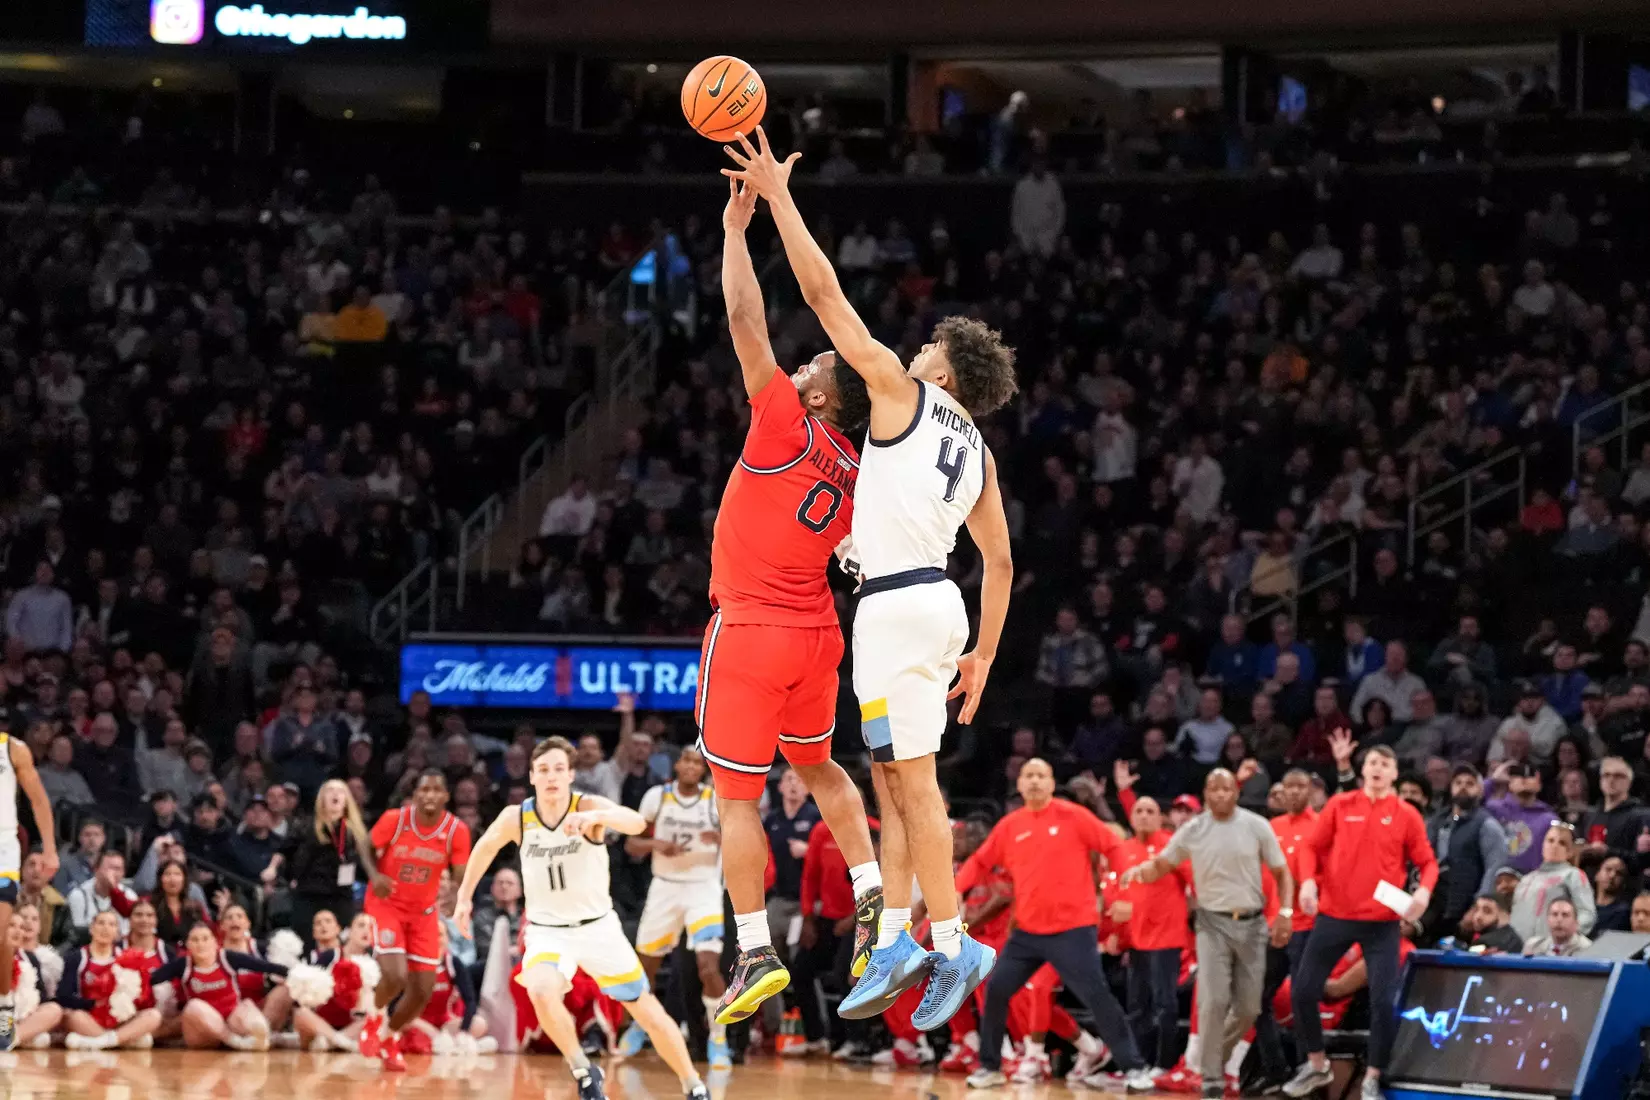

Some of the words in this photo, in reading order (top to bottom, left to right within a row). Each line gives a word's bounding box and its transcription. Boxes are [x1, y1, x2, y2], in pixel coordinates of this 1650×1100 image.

[727, 80, 759, 116] ELITE
[931, 403, 977, 450] MITCHELL
[935, 436, 967, 503] 4
[796, 480, 844, 534] 0
[580, 661, 700, 694] ULTRA
[547, 862, 566, 891] 11
